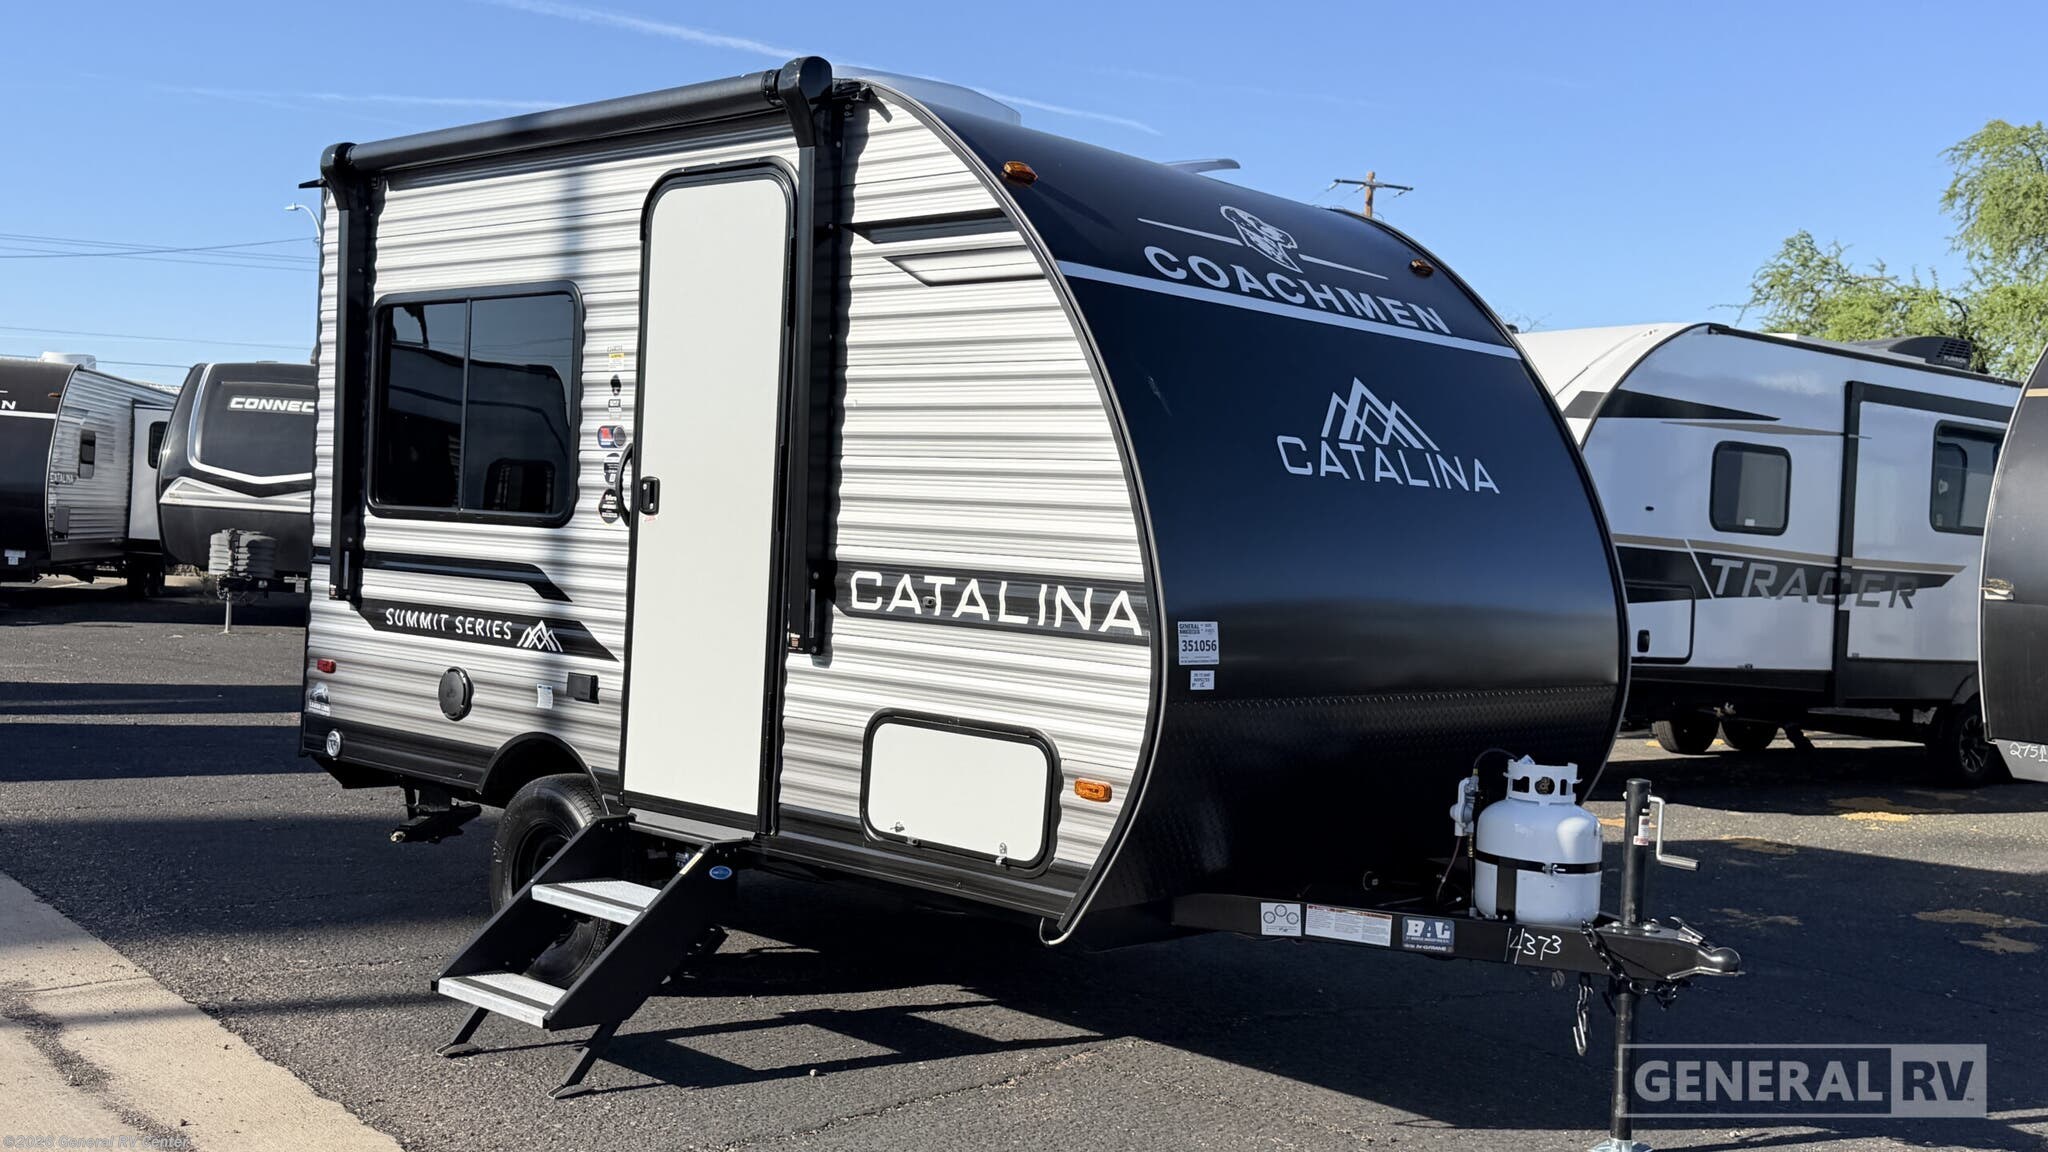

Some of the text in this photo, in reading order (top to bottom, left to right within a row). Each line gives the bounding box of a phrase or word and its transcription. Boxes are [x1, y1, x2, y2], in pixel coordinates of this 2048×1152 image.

[1144, 246, 1451, 335] COACHMEN
[1277, 435, 1500, 494] CATALINA
[851, 570, 1142, 636] CATALINA
[1711, 558, 1919, 609] TRACER
[385, 608, 512, 640] SUMMIT SERIES
[1181, 640, 1217, 652] 351056
